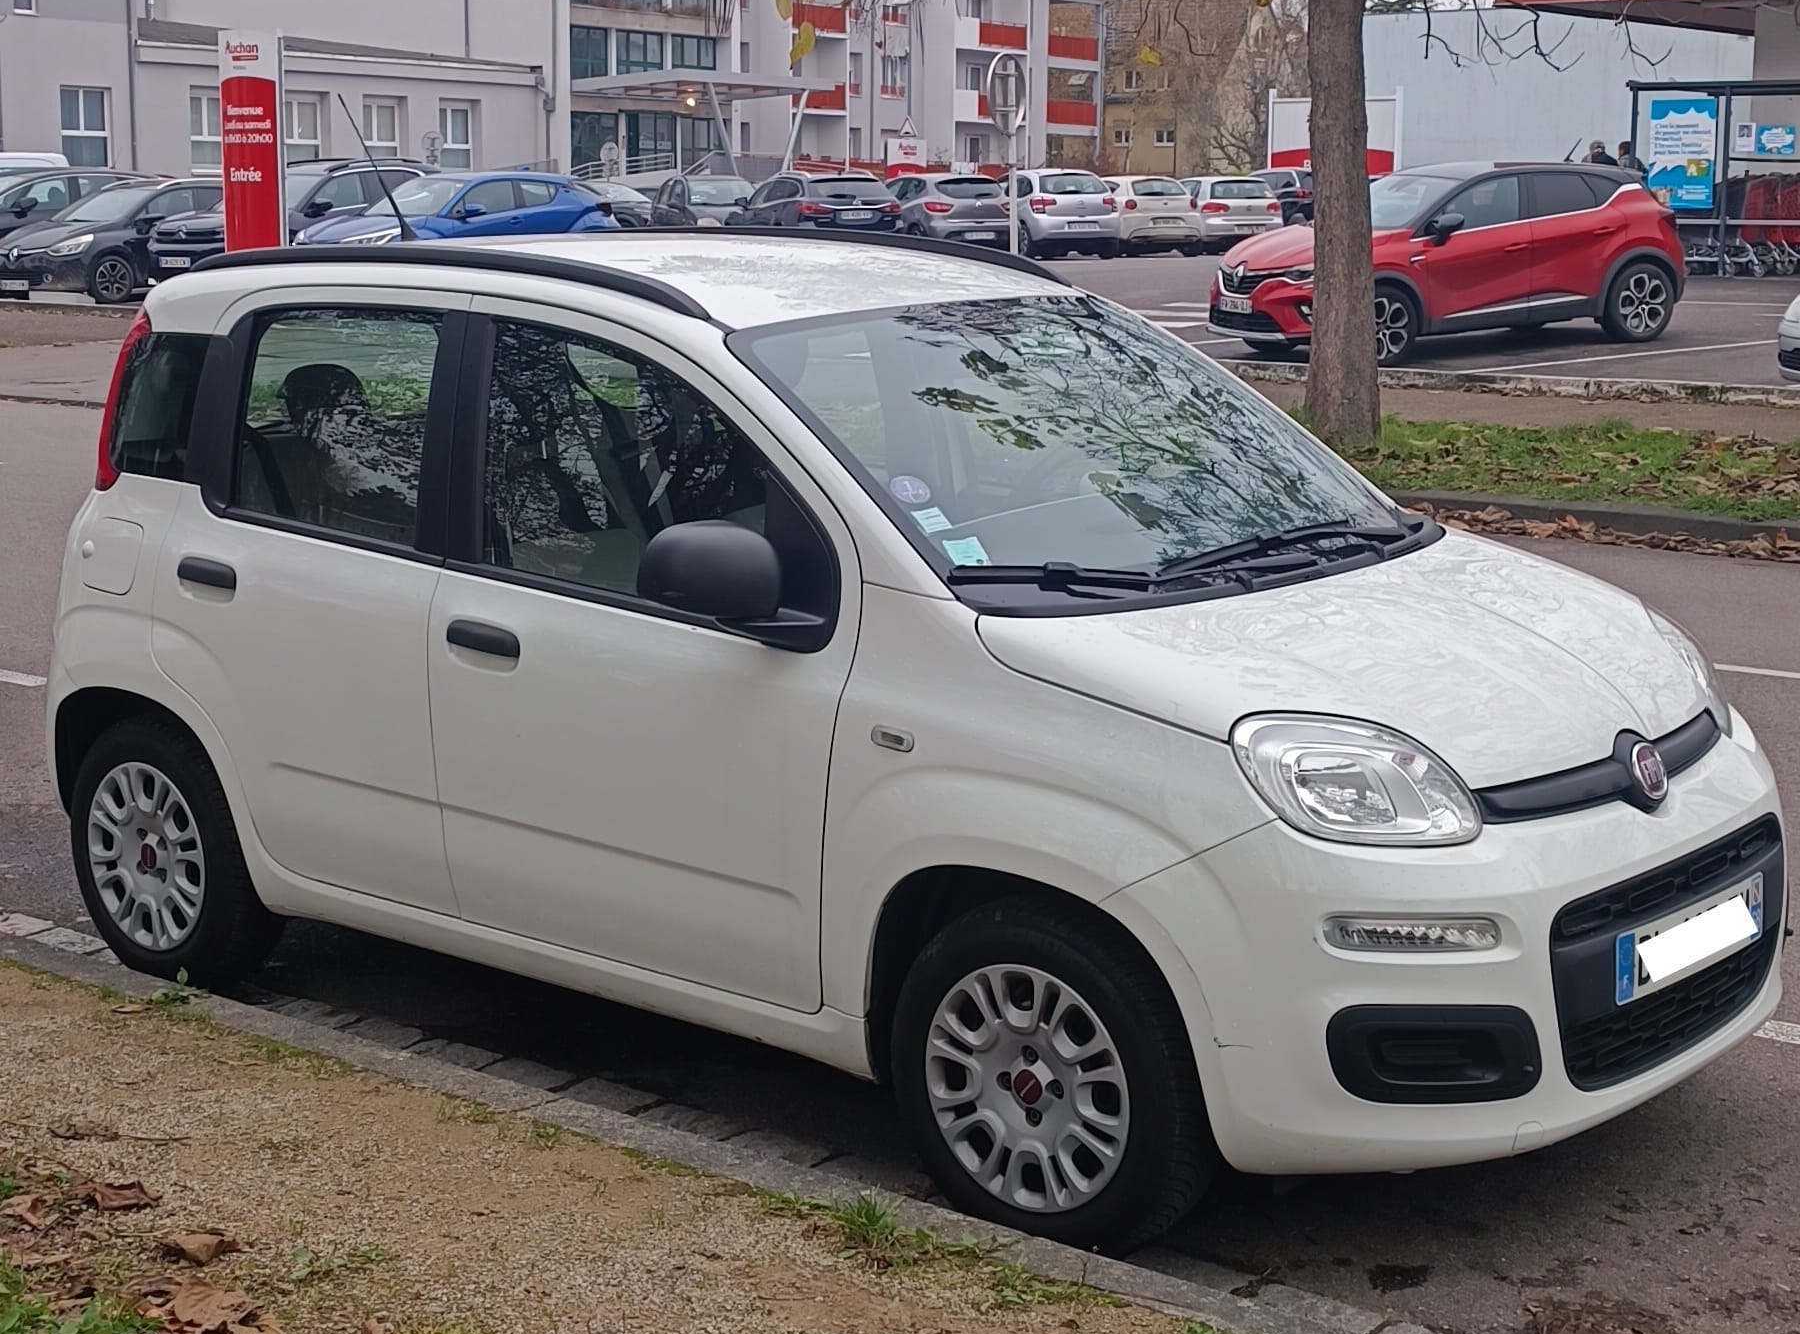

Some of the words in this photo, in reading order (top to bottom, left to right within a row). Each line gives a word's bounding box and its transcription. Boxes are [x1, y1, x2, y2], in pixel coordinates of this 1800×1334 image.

[225, 40, 259, 54] Auchan
[227, 105, 264, 115] Bienvenue
[244, 119, 272, 129] samedi
[247, 133, 273, 143] 20h00
[230, 166, 262, 182] Entrée
